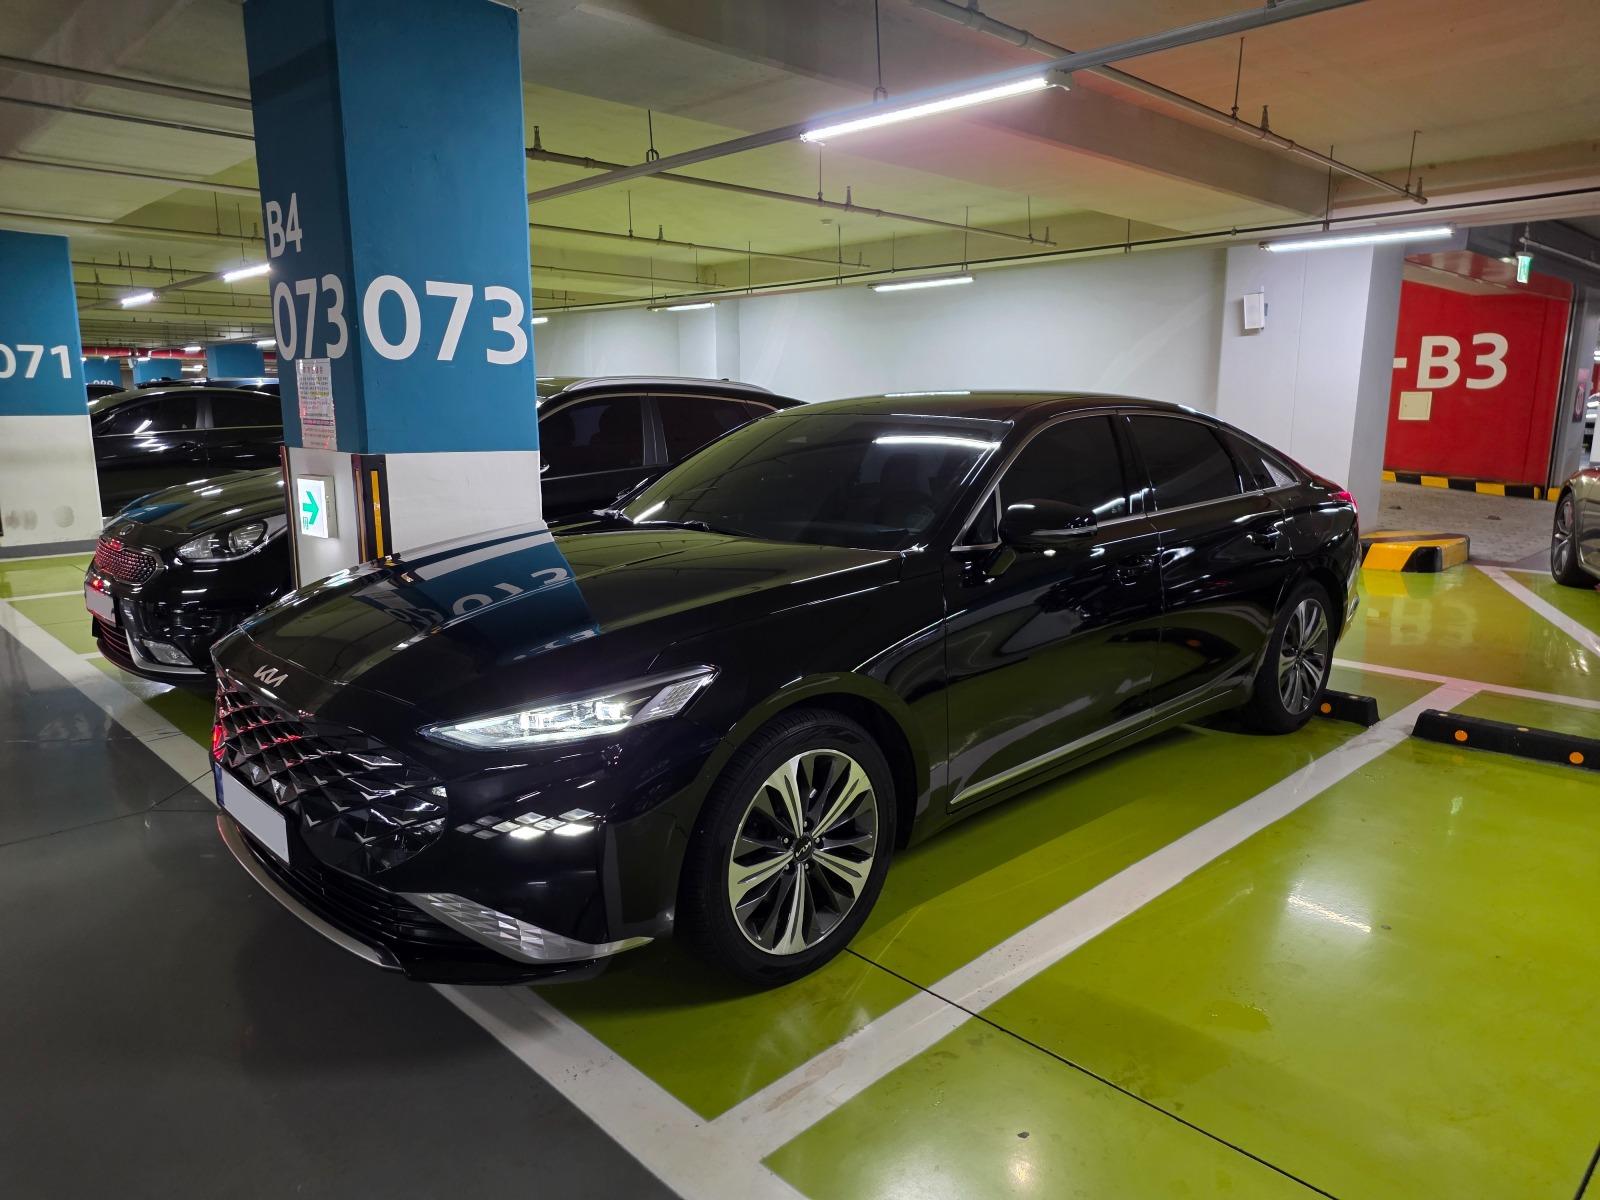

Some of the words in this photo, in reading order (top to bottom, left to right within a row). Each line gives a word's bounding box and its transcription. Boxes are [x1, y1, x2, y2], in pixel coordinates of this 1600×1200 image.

[266, 192, 303, 258] B4
[273, 274, 349, 361] 073
[362, 275, 528, 365] 073
[253, 664, 289, 688] KIA
